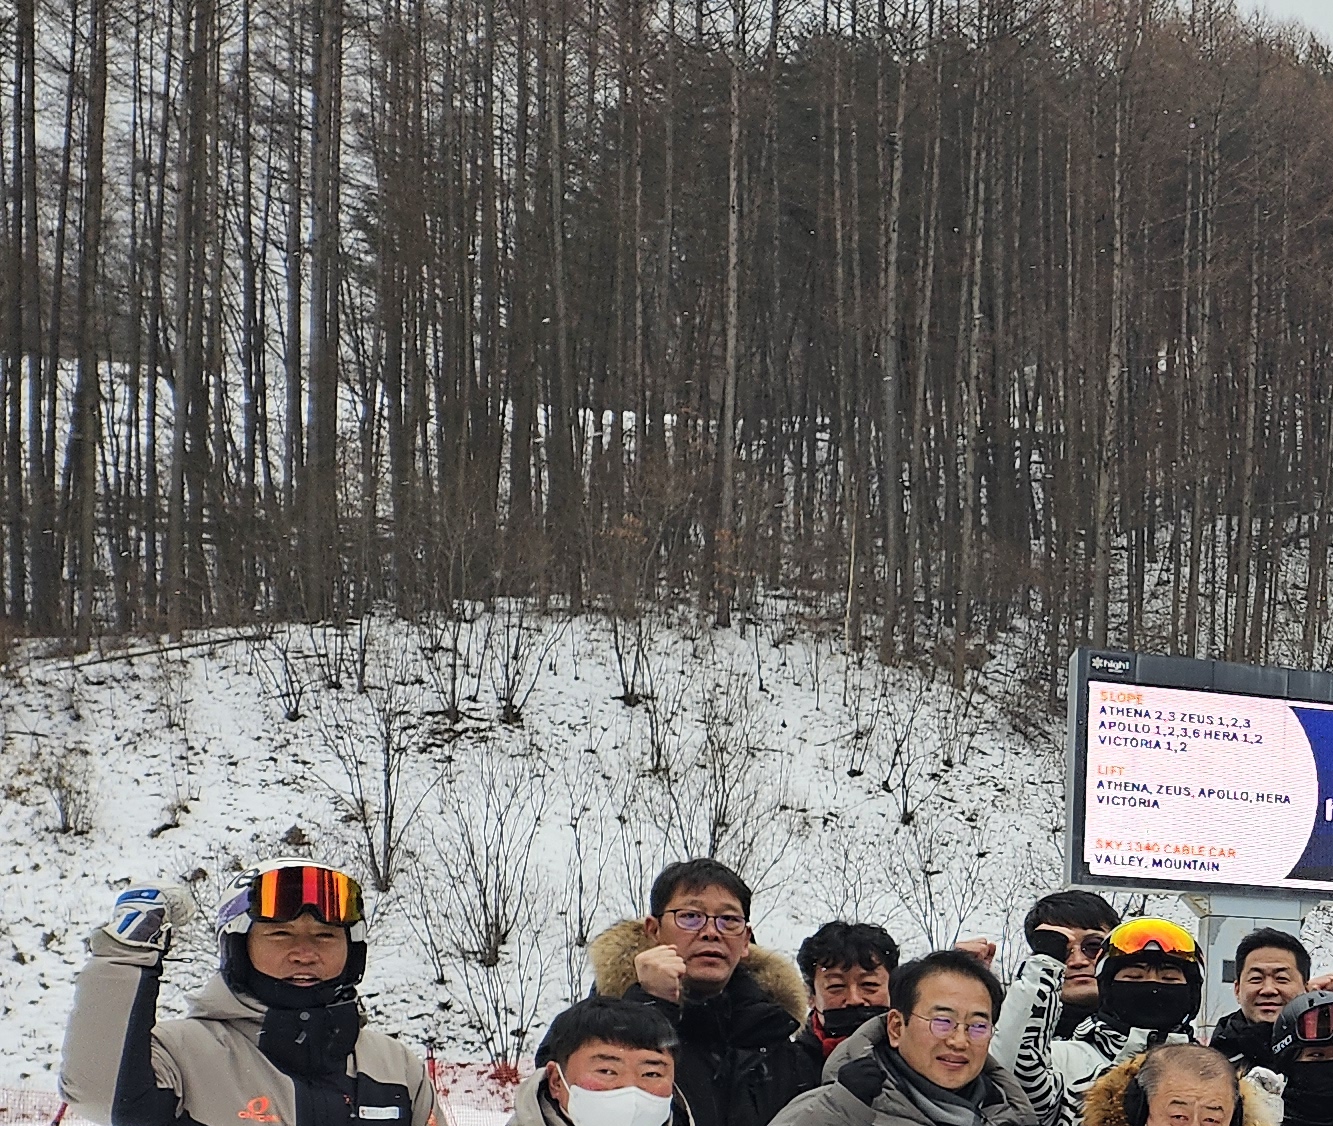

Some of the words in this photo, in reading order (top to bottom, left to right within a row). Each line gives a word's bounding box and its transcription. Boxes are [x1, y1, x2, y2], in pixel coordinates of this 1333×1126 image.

[1100, 691, 1143, 705] SLOPE
[1099, 706, 1151, 719] ATHENA
[1154, 711, 1176, 722] 2,3
[1180, 713, 1214, 725] ZEUS
[1098, 721, 1150, 734] APOLLO
[1204, 728, 1239, 742] HERA
[1098, 735, 1161, 750] VICTORIA
[1097, 764, 1125, 776] LIFT
[1097, 795, 1160, 809] VICTORIA
[1256, 792, 1291, 805] HERA
[1095, 838, 1122, 850] SKY
[1163, 844, 1205, 857] CABLE
[1209, 847, 1237, 859] CAR
[1151, 857, 1220, 872] MOUNTAIN
